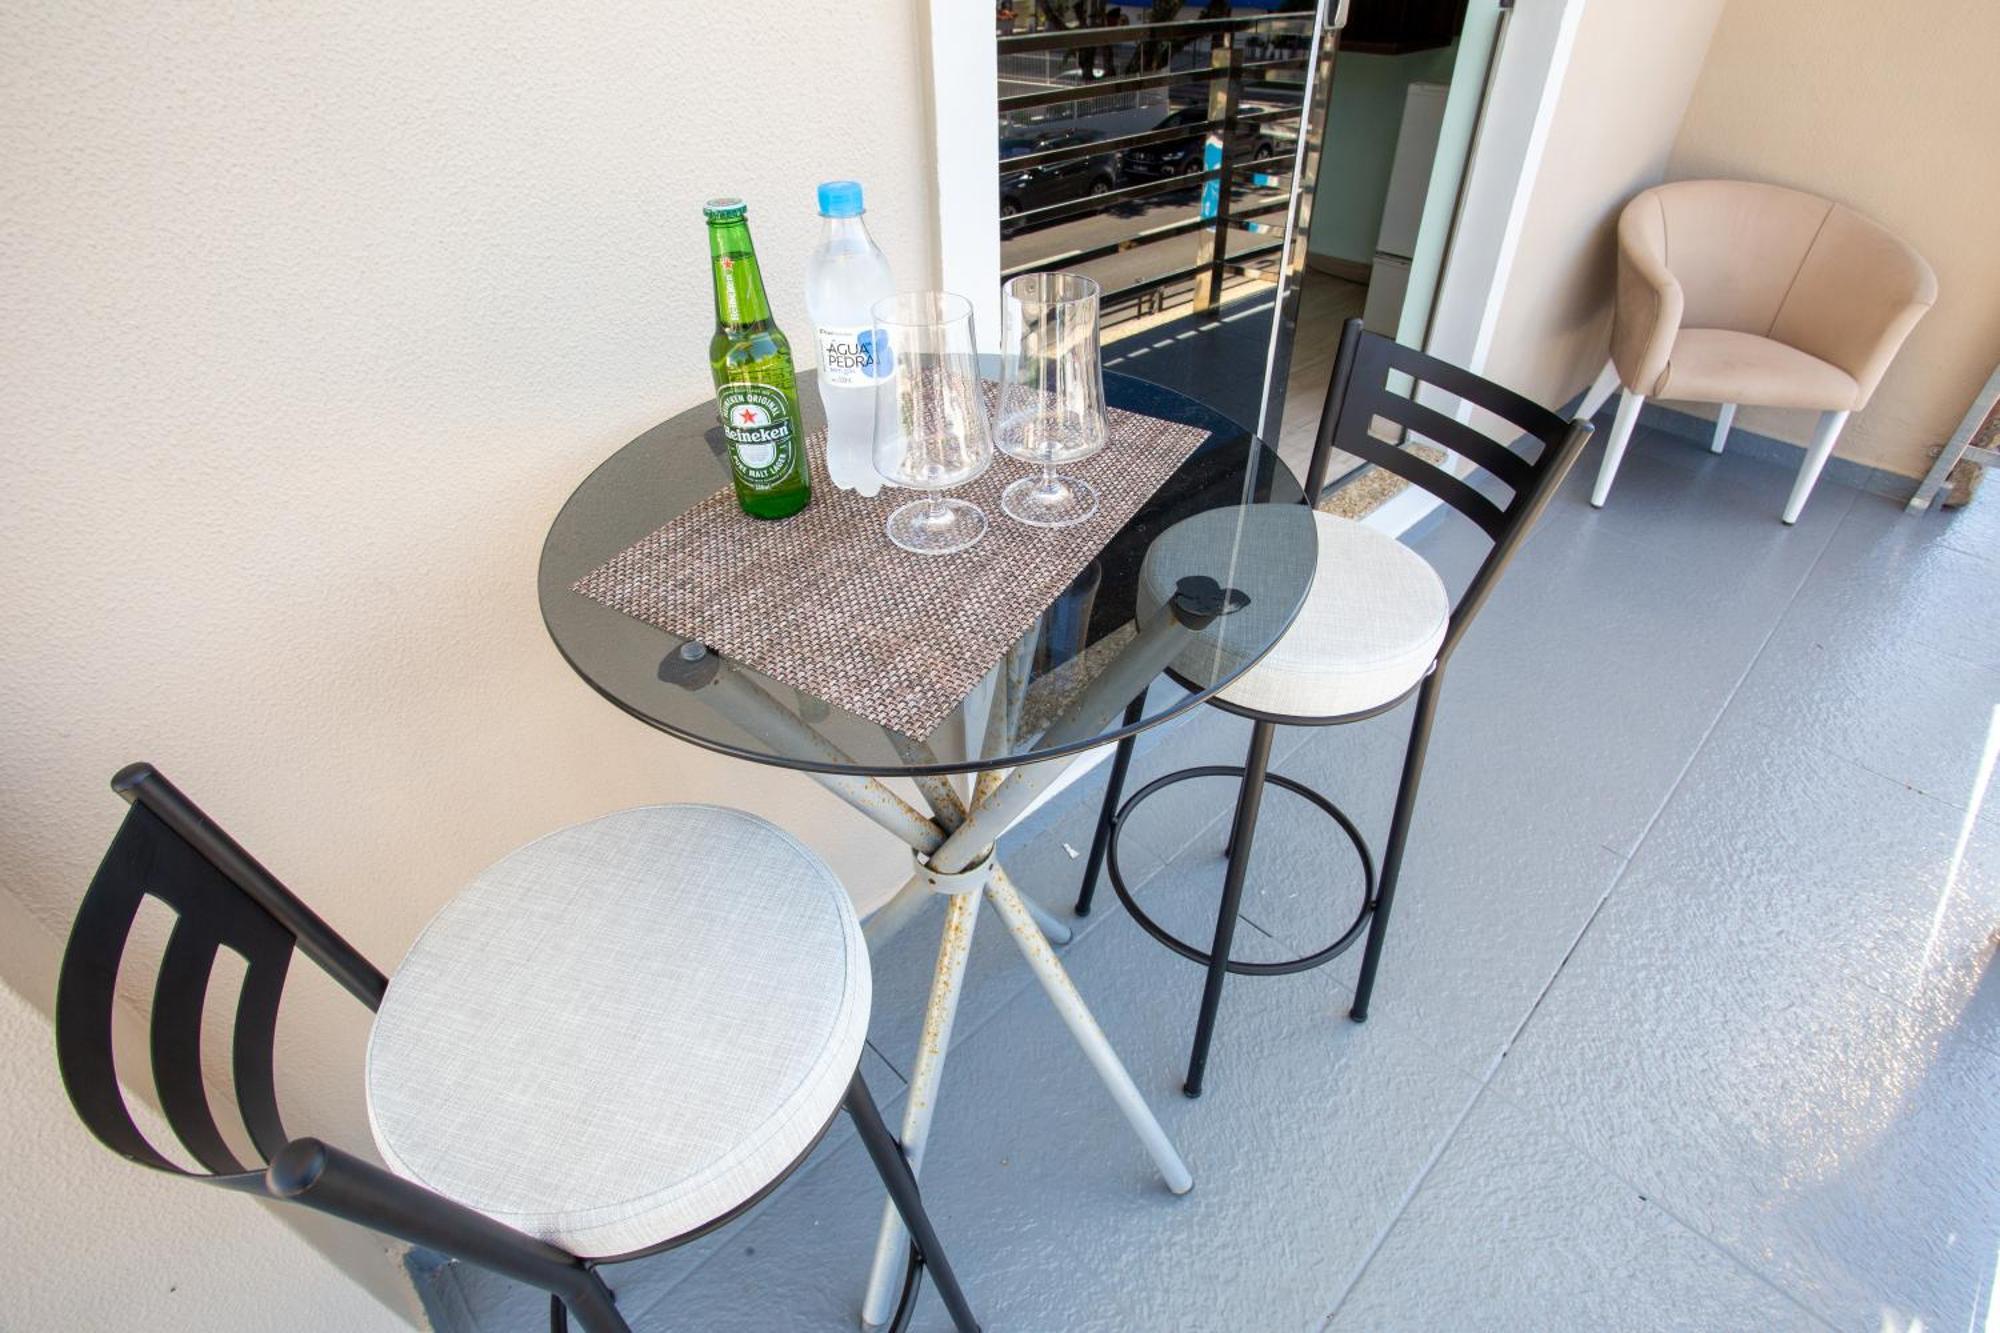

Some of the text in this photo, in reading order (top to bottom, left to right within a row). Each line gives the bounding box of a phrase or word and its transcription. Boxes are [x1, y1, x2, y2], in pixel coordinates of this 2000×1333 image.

[828, 355, 874, 368] PEDRA
[746, 394, 780, 417] ORIGINAL
[724, 424, 789, 443] Heineken
